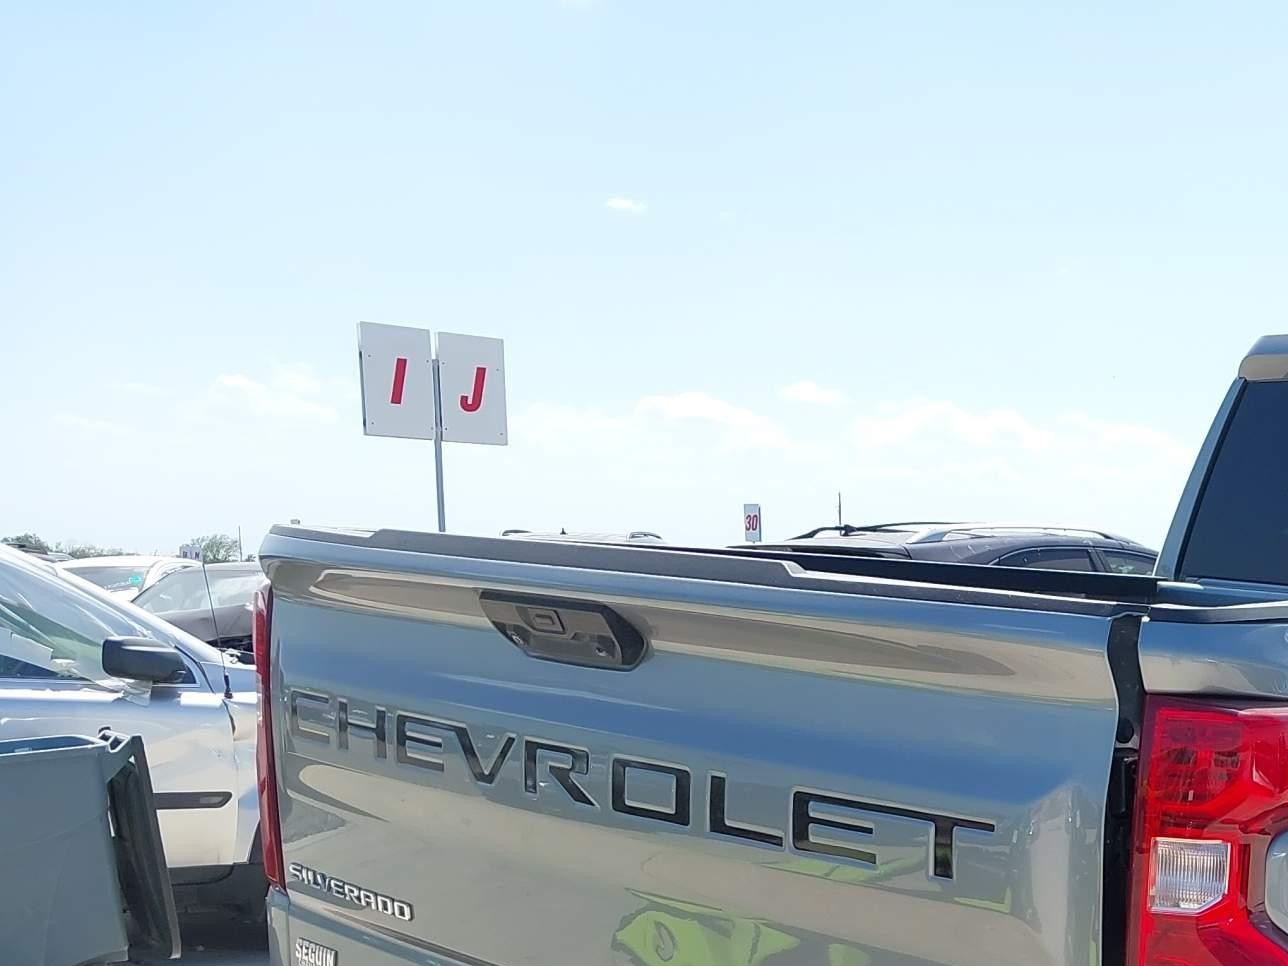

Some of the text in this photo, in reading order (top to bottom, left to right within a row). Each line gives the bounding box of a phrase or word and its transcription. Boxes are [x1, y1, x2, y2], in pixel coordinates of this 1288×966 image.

[390, 356, 408, 406] I
[459, 365, 488, 414] J
[745, 513, 759, 532] 30
[289, 689, 996, 881] CHEVROLET
[288, 861, 413, 921] SILVERADO
